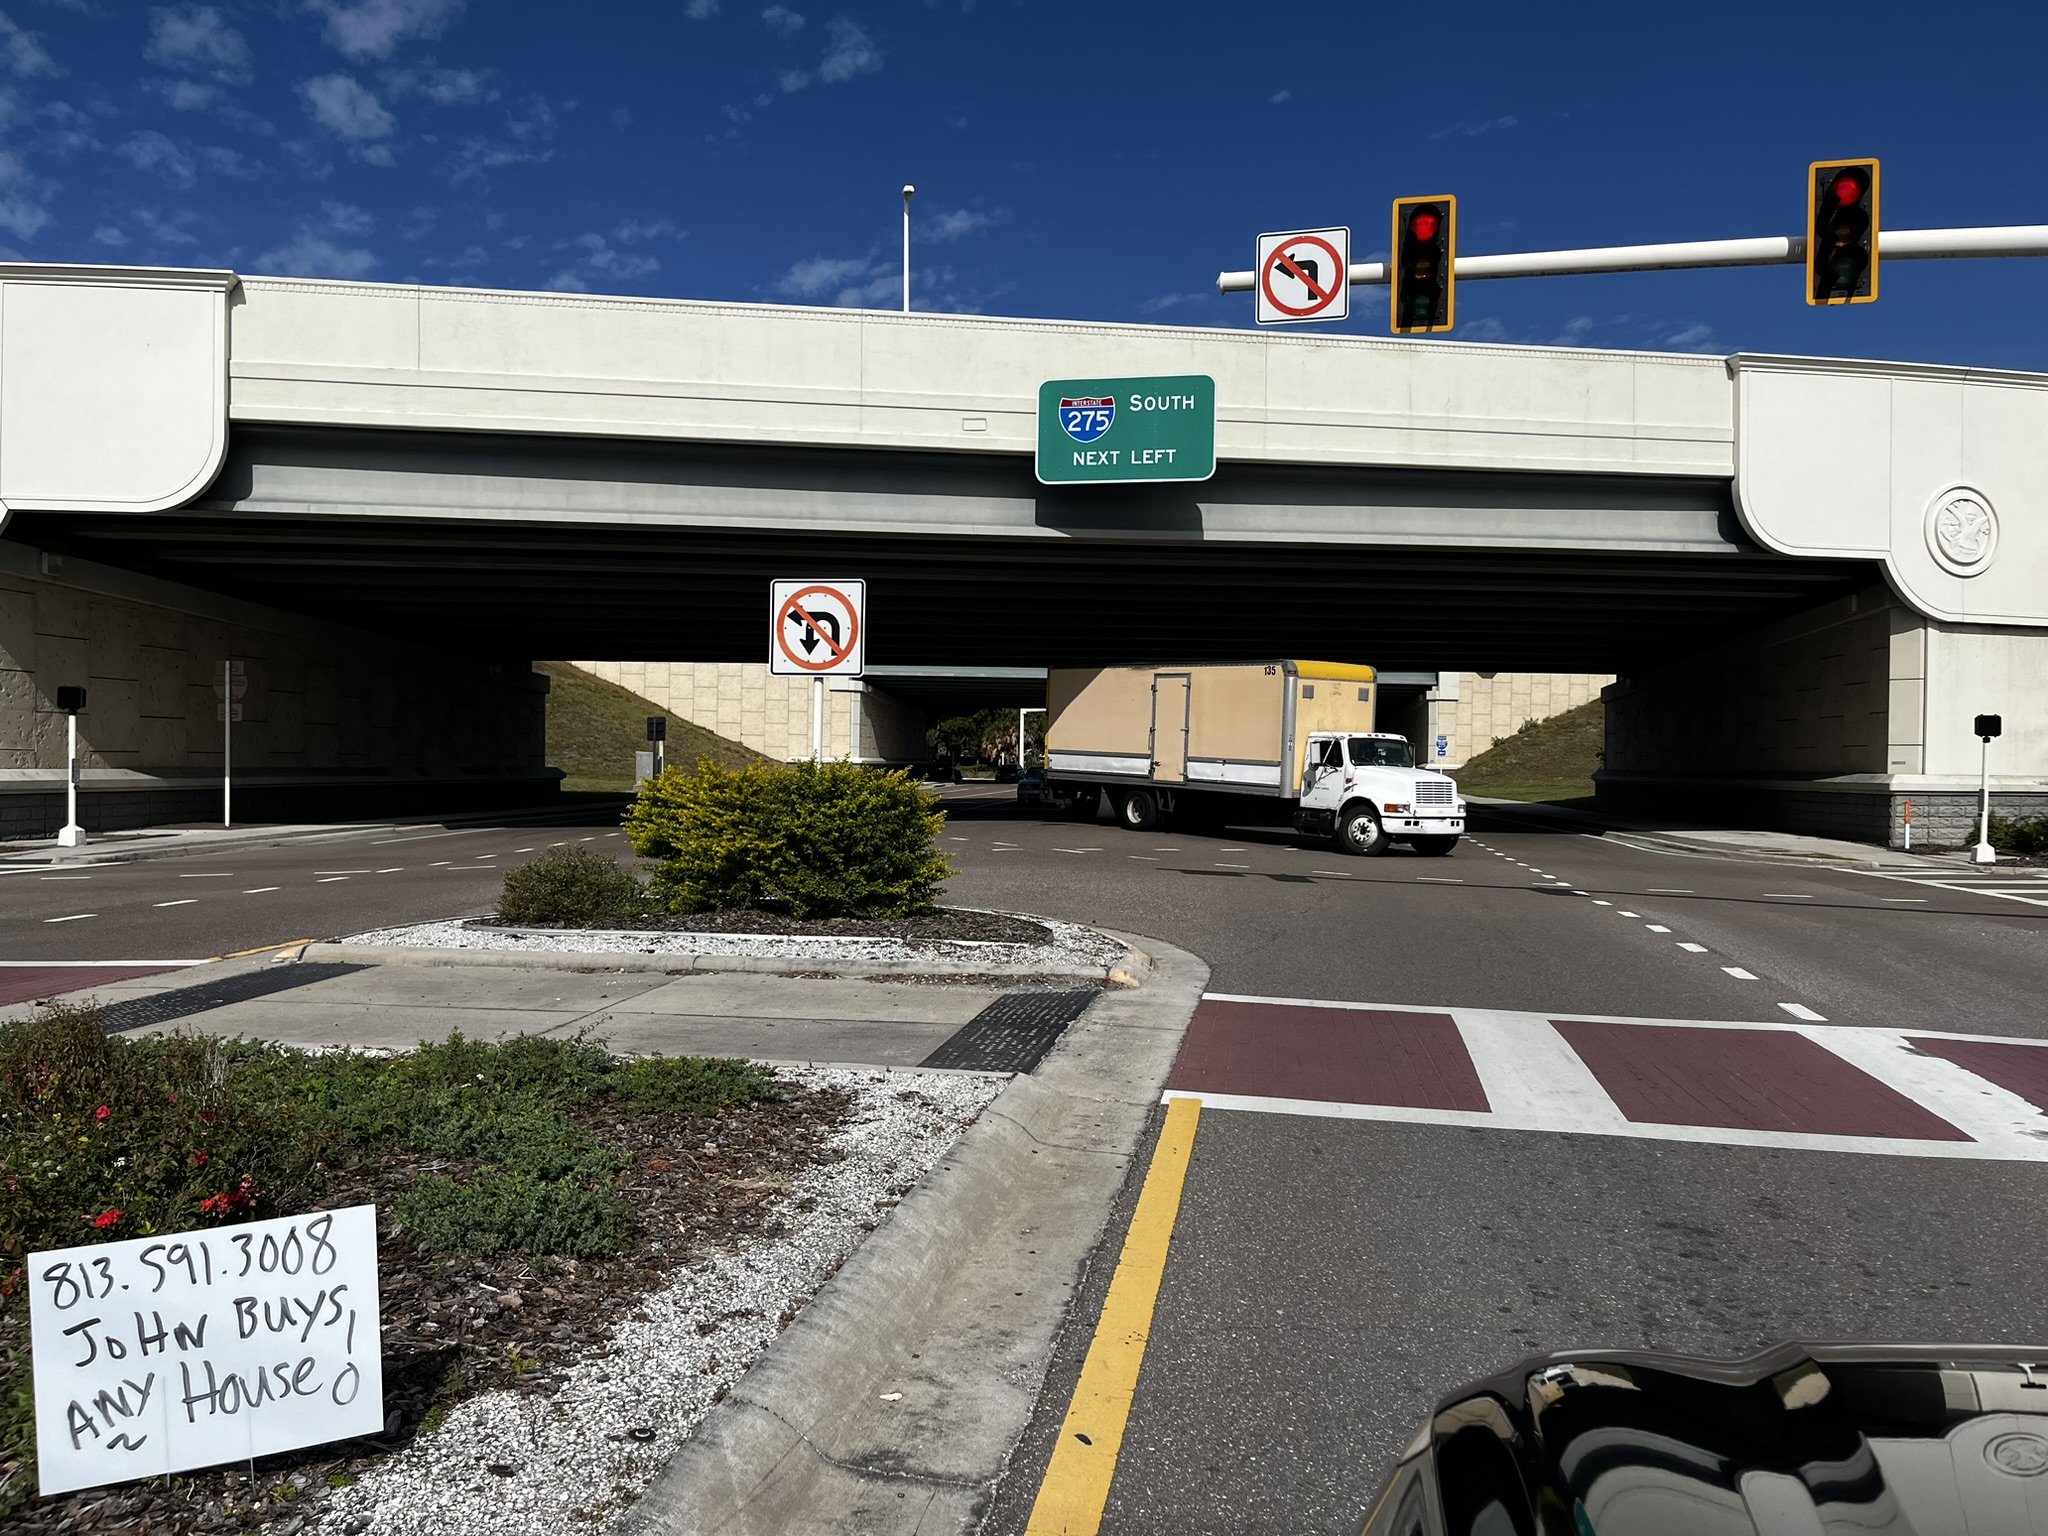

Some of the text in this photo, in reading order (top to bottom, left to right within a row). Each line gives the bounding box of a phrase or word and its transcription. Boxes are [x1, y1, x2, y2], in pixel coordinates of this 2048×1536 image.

[1129, 394, 1195, 411] SOUTH
[1067, 410, 1110, 432] 275
[1073, 449, 1177, 466] NEXT LEFT
[1263, 665, 1276, 676] 135
[42, 1213, 338, 1311] 813.591.3008
[66, 1371, 155, 1450] ANY
